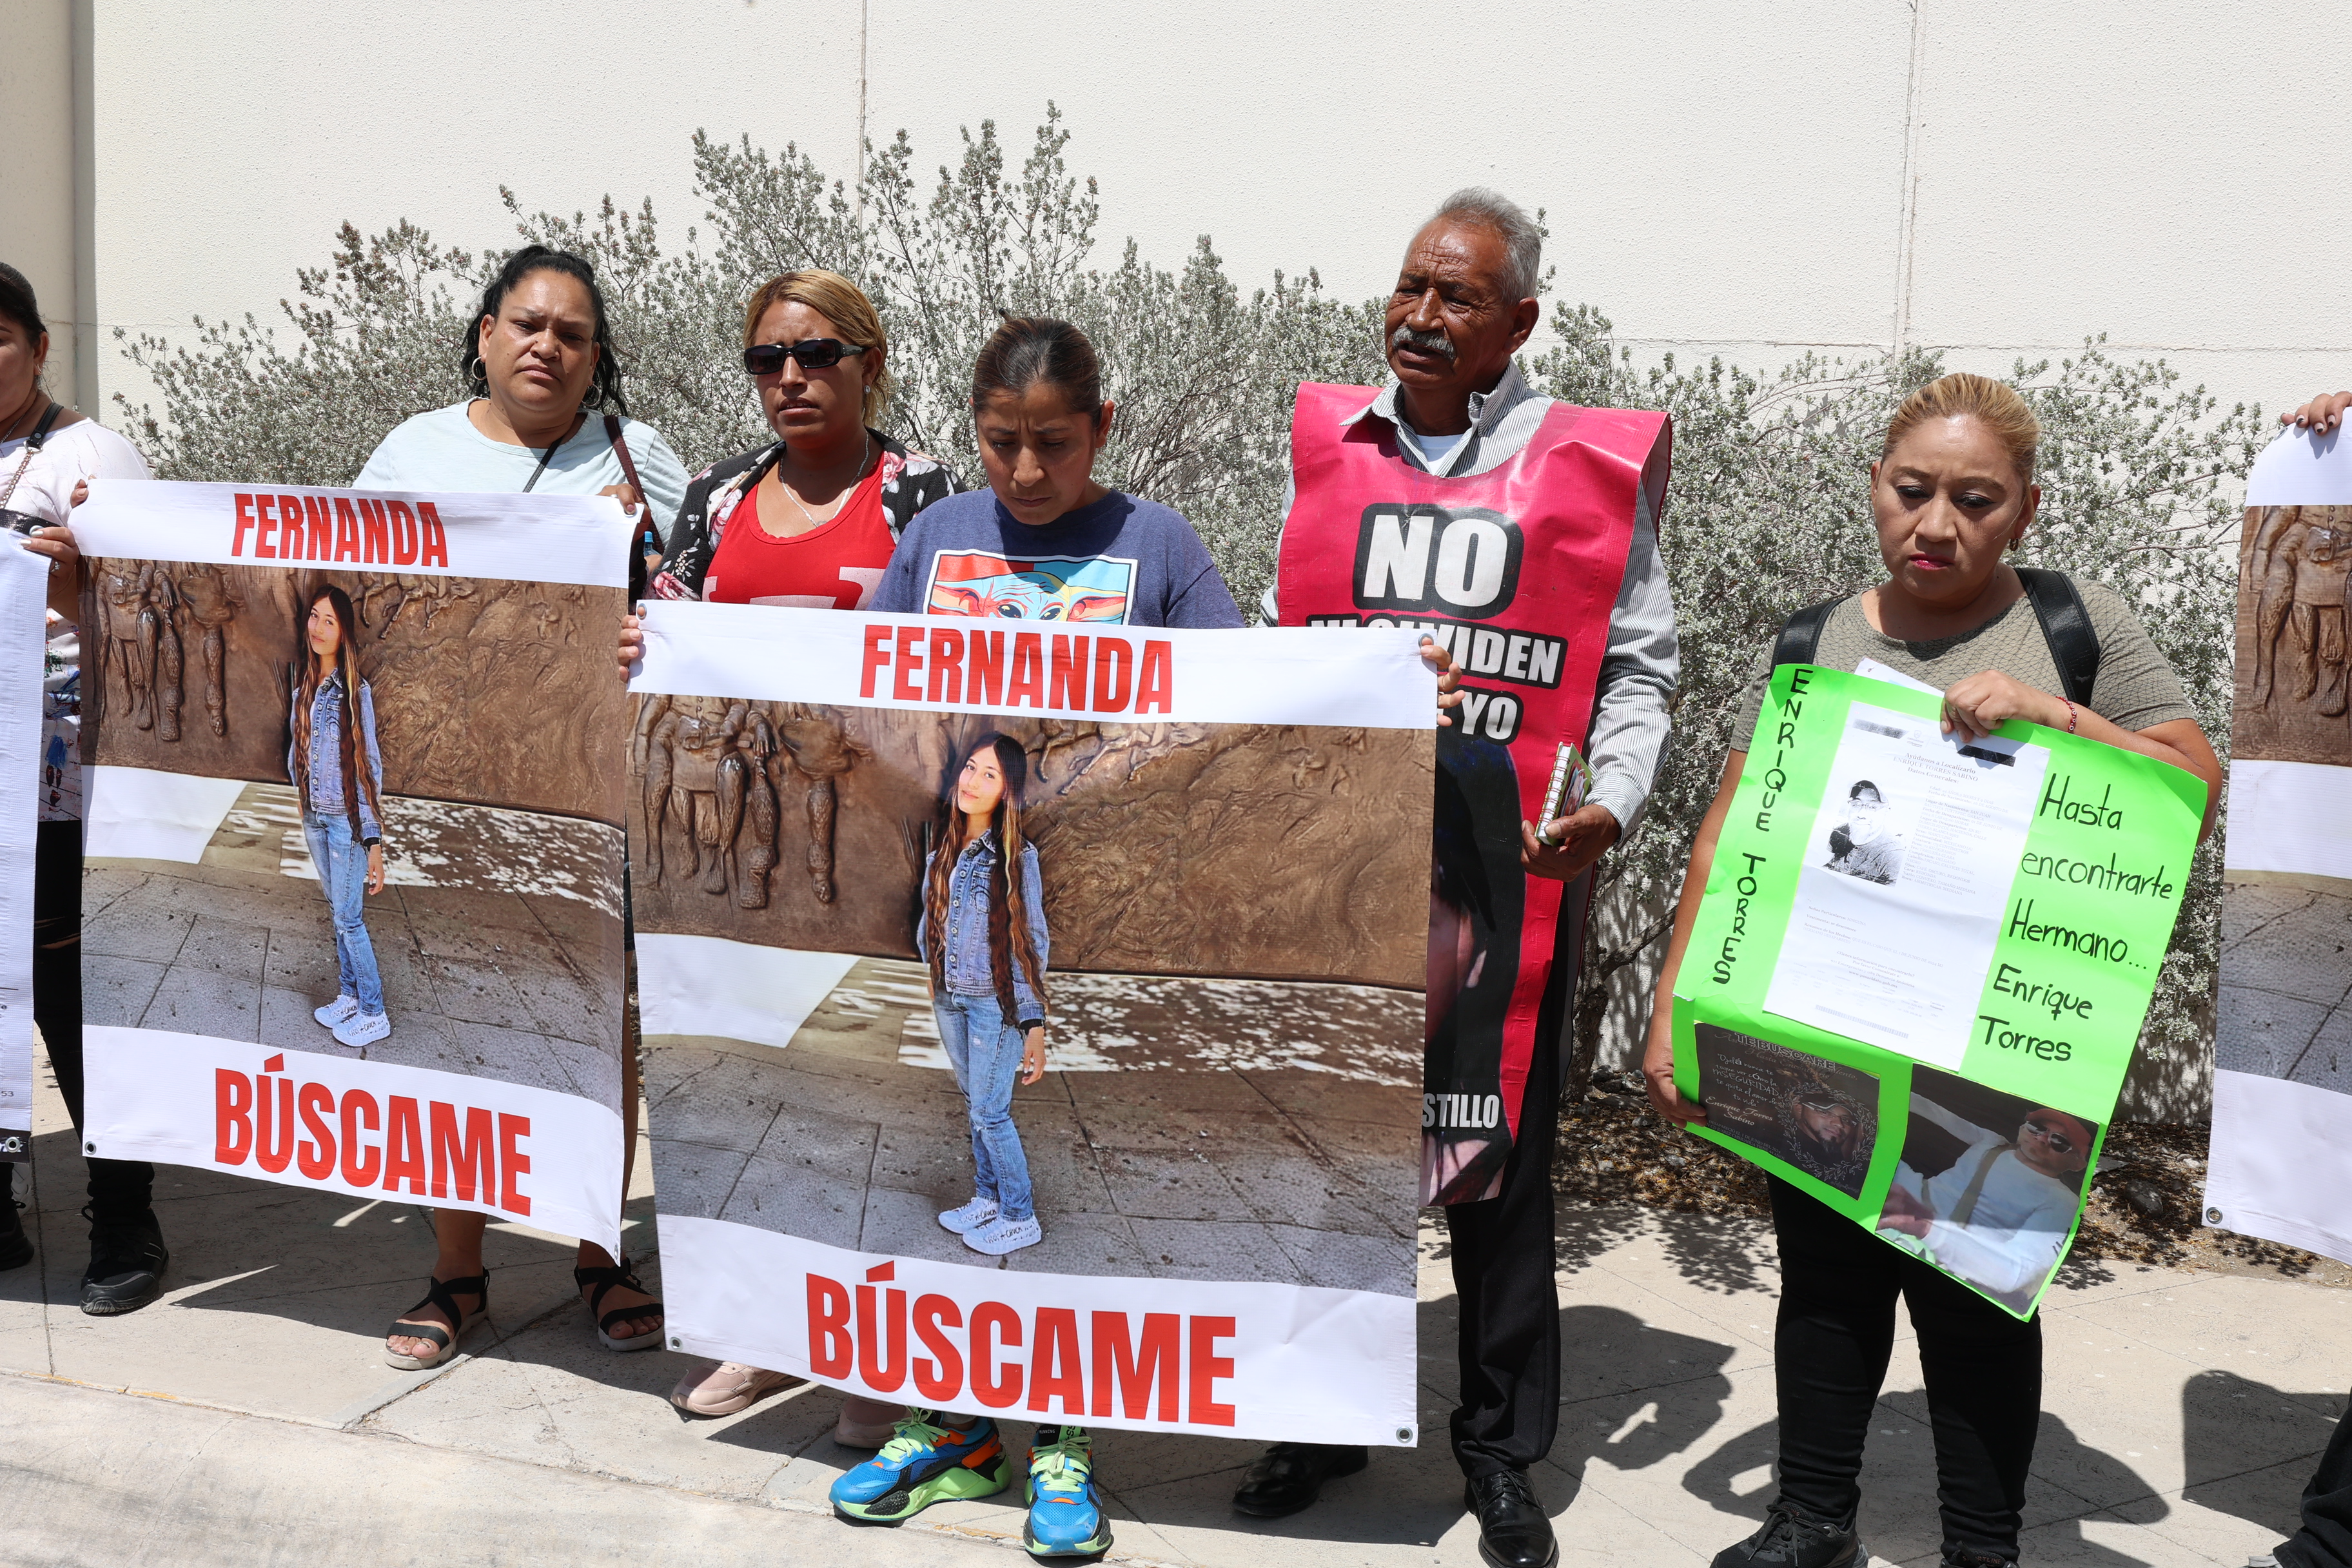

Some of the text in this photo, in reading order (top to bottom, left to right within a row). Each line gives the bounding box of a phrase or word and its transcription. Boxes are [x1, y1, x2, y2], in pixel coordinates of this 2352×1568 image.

[231, 493, 448, 567] FERNANDA
[1363, 514, 1507, 607] NO
[859, 624, 1172, 714] FERNANDA
[1367, 618, 1561, 683] VIDEN
[1460, 691, 1518, 740] YO
[1893, 756, 1978, 781] ENRIQUE TORRES SABINO
[1906, 752, 1935, 763] Ayúdanos
[1941, 761, 1975, 774] Localizarlo
[1907, 767, 1959, 783] Datos Generales:
[2039, 773, 2122, 830] Hasta
[1713, 669, 1814, 985] ENRIQUE TORRES
[2021, 852, 2173, 899] encontrarte
[2008, 898, 2147, 969] Hermano...
[1994, 963, 2093, 1020] Enrique
[1734, 1032, 1756, 1047] TE
[1757, 1039, 1836, 1072] BUSCARE
[1979, 1015, 2072, 1061] Torres
[1725, 1083, 1743, 1092] quita
[1744, 1087, 1751, 1097] el
[1743, 1063, 1763, 1072] nunca
[1770, 1077, 1778, 1086] la
[1705, 1095, 1772, 1121] Enrique Torres
[1723, 1104, 1754, 1126] Sabino
[215, 1053, 531, 1217] BÚSCAME
[806, 1260, 1236, 1427] BÚSCAME
[1962, 1556, 2001, 1564] SRTLINE
